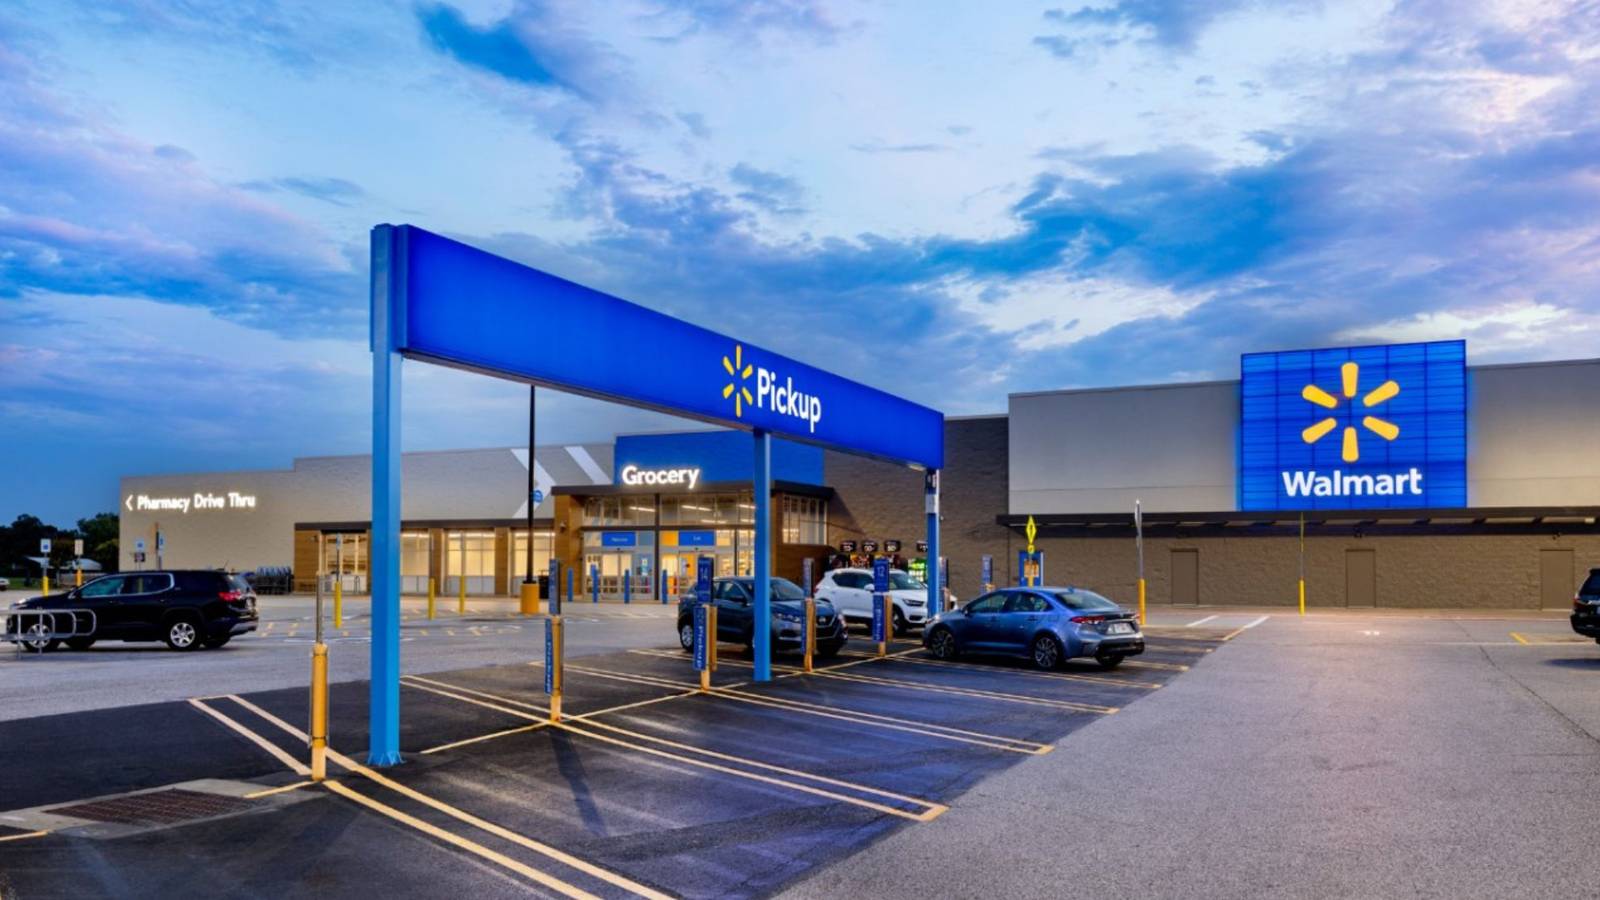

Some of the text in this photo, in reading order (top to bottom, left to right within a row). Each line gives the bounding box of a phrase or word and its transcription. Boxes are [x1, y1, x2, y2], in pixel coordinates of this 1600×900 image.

[757, 367, 821, 433] Pickup
[622, 465, 700, 489] Grocery
[1282, 467, 1423, 497] Walmart
[137, 492, 256, 513] Pharmacy Drive Thru
